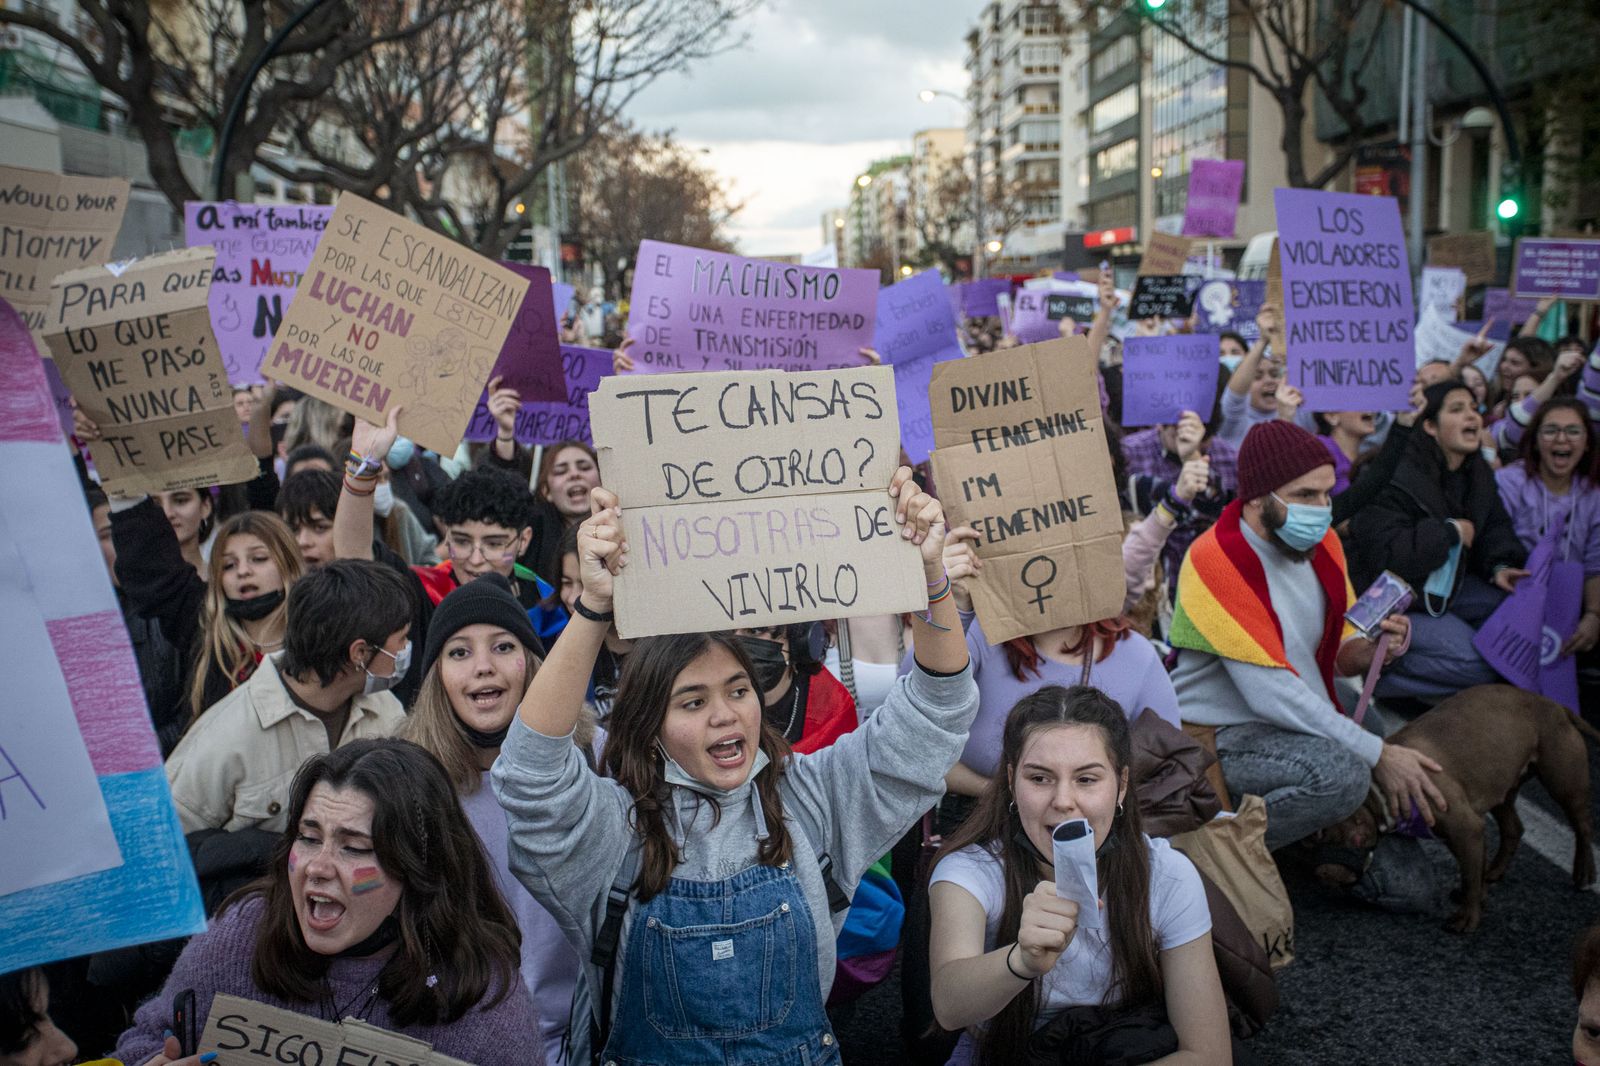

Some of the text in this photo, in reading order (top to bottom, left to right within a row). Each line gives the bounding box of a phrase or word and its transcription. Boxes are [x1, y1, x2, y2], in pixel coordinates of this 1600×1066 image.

[75, 193, 117, 212] YOUR
[1317, 206, 1364, 236] LOS
[2, 226, 103, 261] MOMMY
[1285, 240, 1400, 269] VIOLADORES
[211, 267, 242, 284] as
[323, 246, 429, 307] POR LAS QUE
[337, 213, 523, 322] SE ESCANDALIZAN
[654, 254, 673, 278] EL
[59, 282, 146, 324] PARA
[163, 268, 210, 293] QUE
[308, 271, 416, 339] LUCHAN
[648, 296, 866, 332] ES UNA ENFERMEDAD
[1291, 279, 1402, 310] EXISTIERON
[65, 314, 173, 355] LO QUE
[347, 322, 380, 352] NO
[446, 302, 486, 333] 8M
[644, 326, 672, 347] DE
[1290, 319, 1409, 346] ANTES DE LAS
[88, 358, 124, 391] ME
[142, 337, 206, 378] PASÓ
[286, 323, 385, 378] POR LAS QUE
[643, 350, 686, 370] ORAL
[724, 357, 743, 372] SU
[271, 342, 392, 414] MUEREN
[1300, 358, 1403, 388] MINIFALDAS
[106, 385, 206, 424] NUNCA
[616, 378, 884, 445] TE CANSAS
[950, 376, 1034, 414] DIVINE
[101, 425, 223, 468] TE PASE
[971, 408, 1095, 454] FEMENINE,
[661, 437, 876, 500] DE OIRLO?
[962, 473, 1003, 502] I'M
[641, 504, 894, 570] NOSOTRAS DE
[970, 494, 1098, 548] FEMENINE
[701, 562, 859, 621] VIVIRLO
[216, 1014, 324, 1066] SIGO
